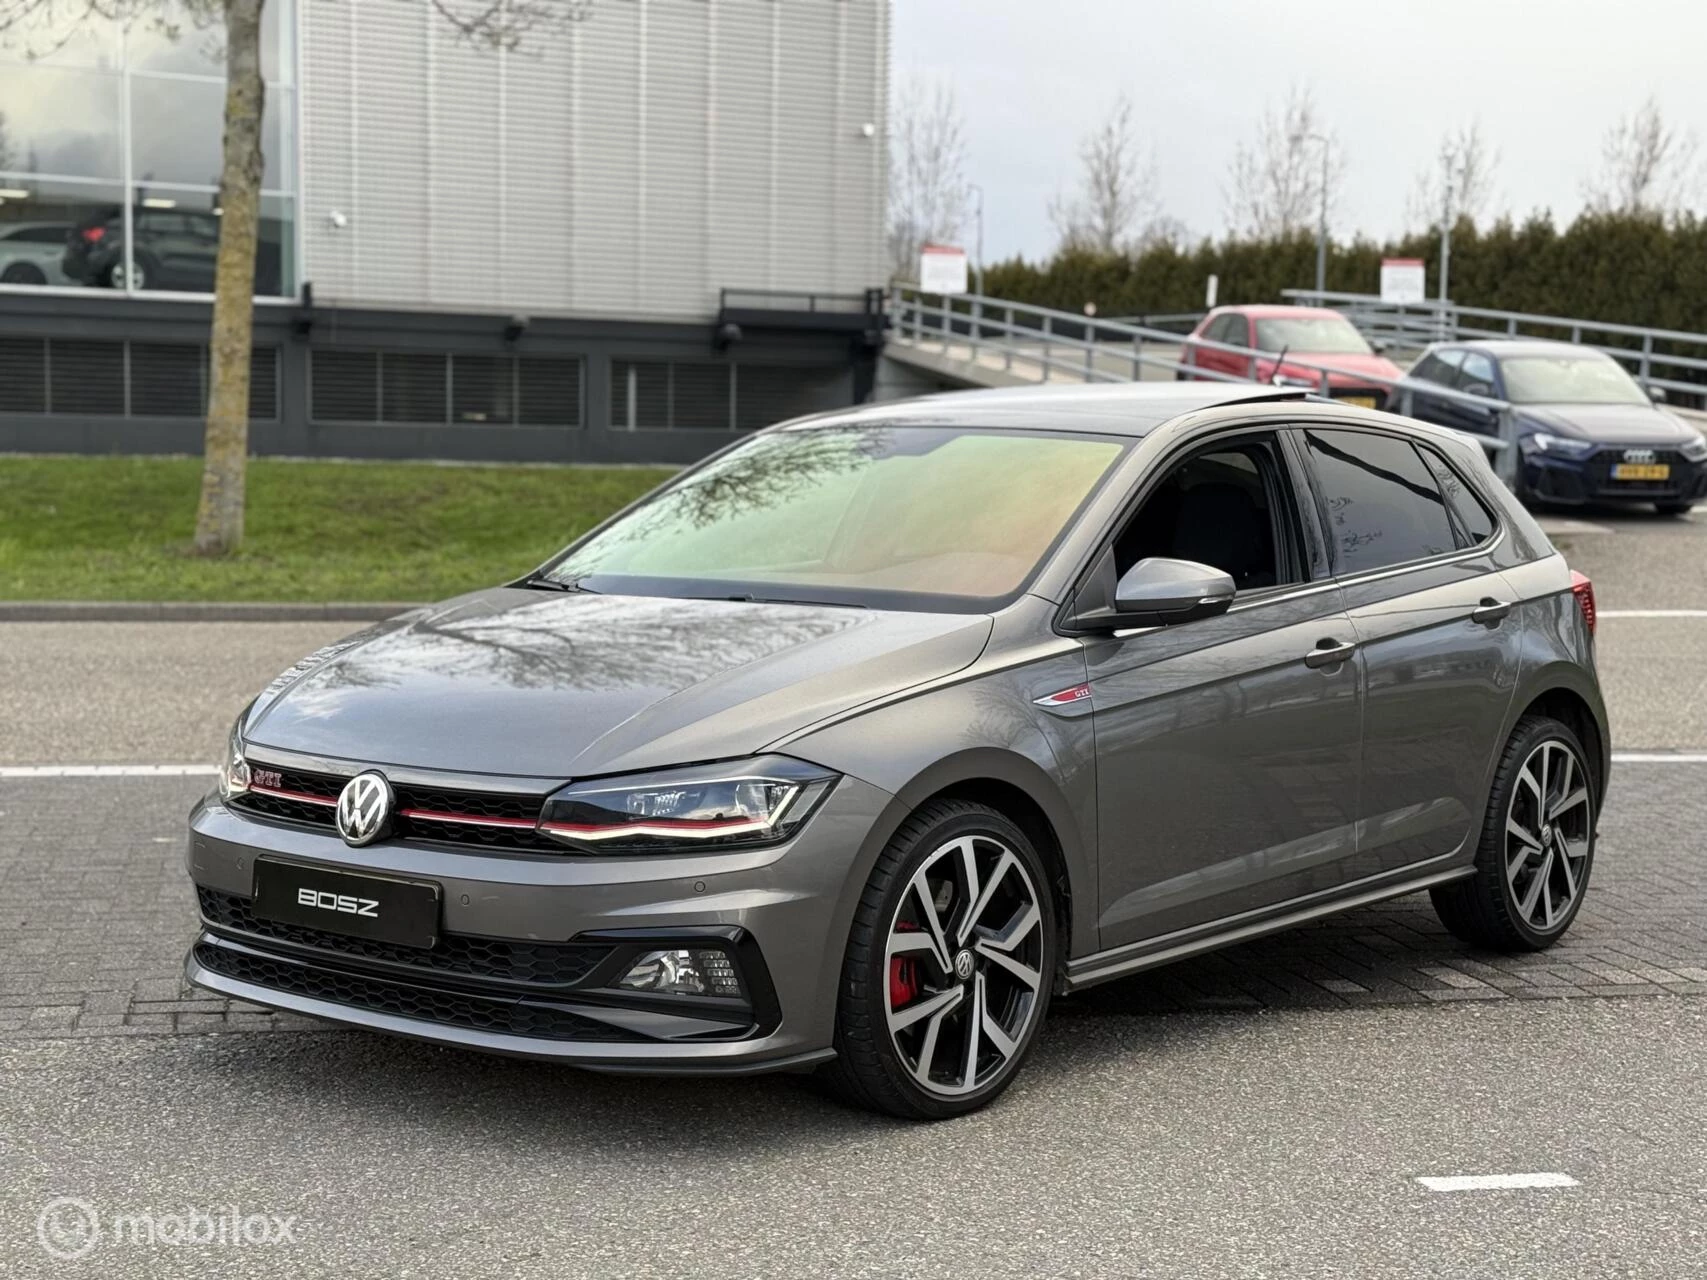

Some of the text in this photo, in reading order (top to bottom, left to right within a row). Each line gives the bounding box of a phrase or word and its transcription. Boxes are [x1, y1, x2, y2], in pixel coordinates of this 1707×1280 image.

[1074, 688, 1090, 698] GTI
[254, 769, 282, 788] GTI
[297, 887, 380, 918] BOSZ
